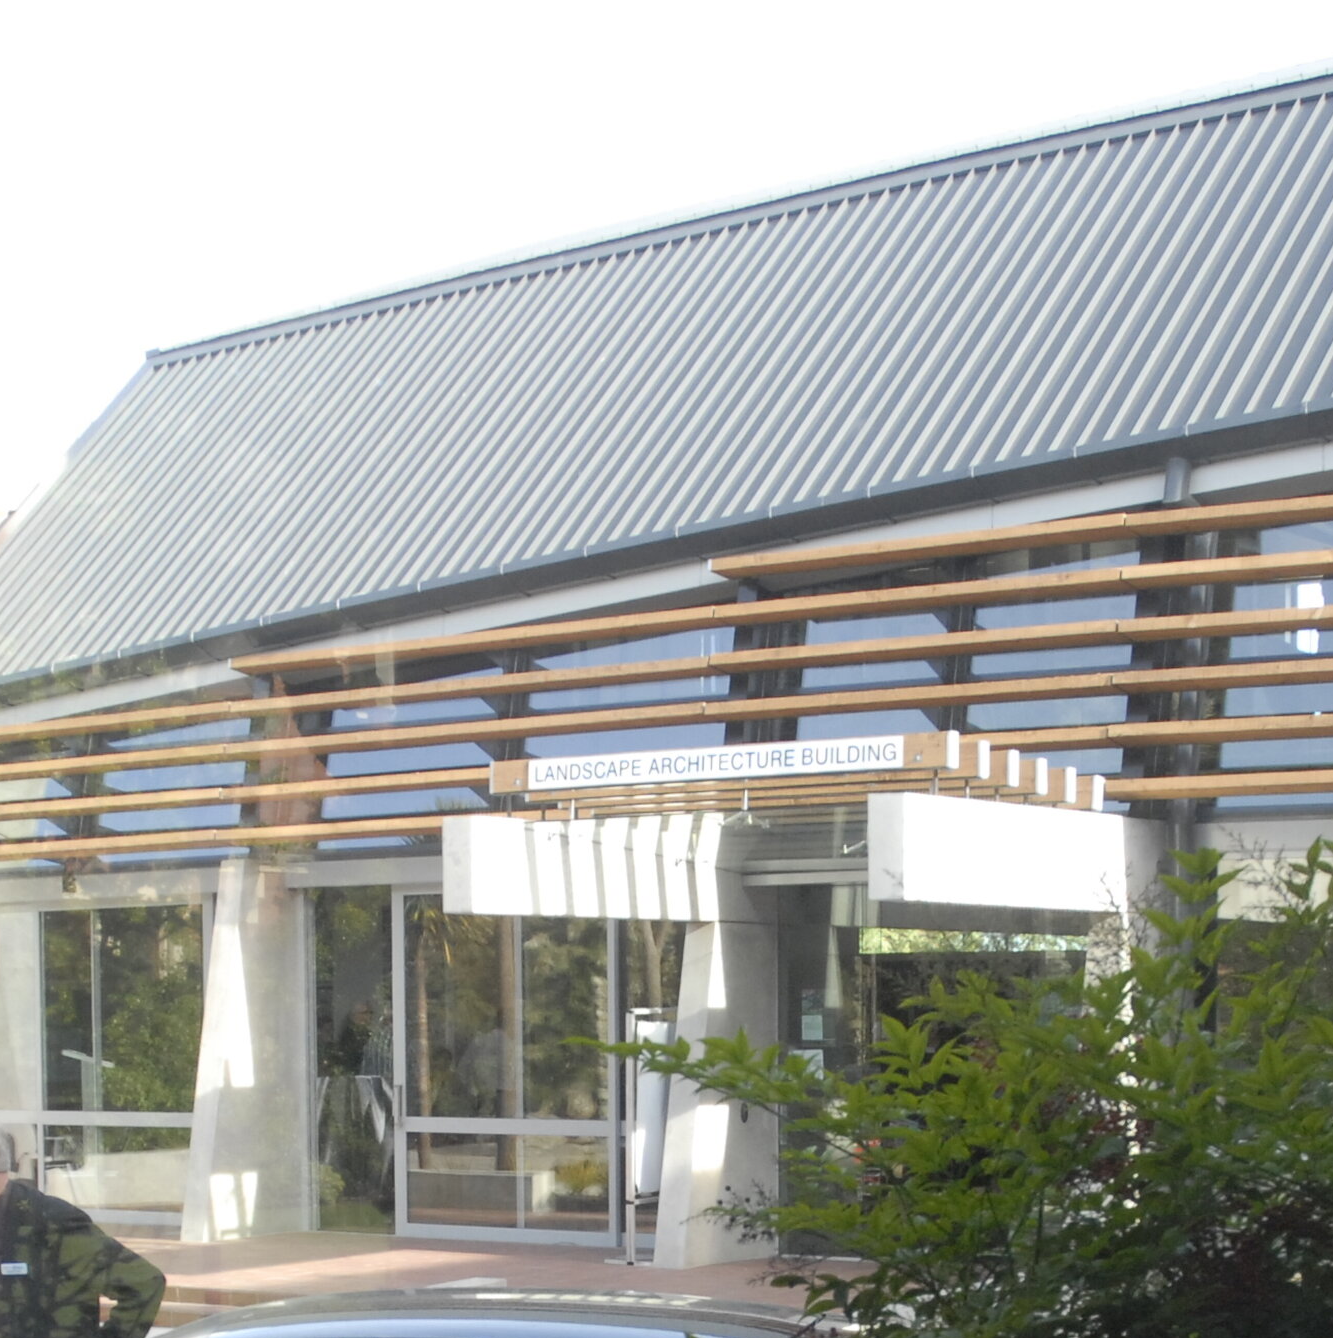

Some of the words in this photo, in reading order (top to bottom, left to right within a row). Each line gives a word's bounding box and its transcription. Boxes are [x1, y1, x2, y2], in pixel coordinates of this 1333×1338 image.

[534, 758, 641, 783] LANDSCAPE
[648, 748, 795, 776] ARCHITECTURE
[801, 743, 897, 766] BUILDING
